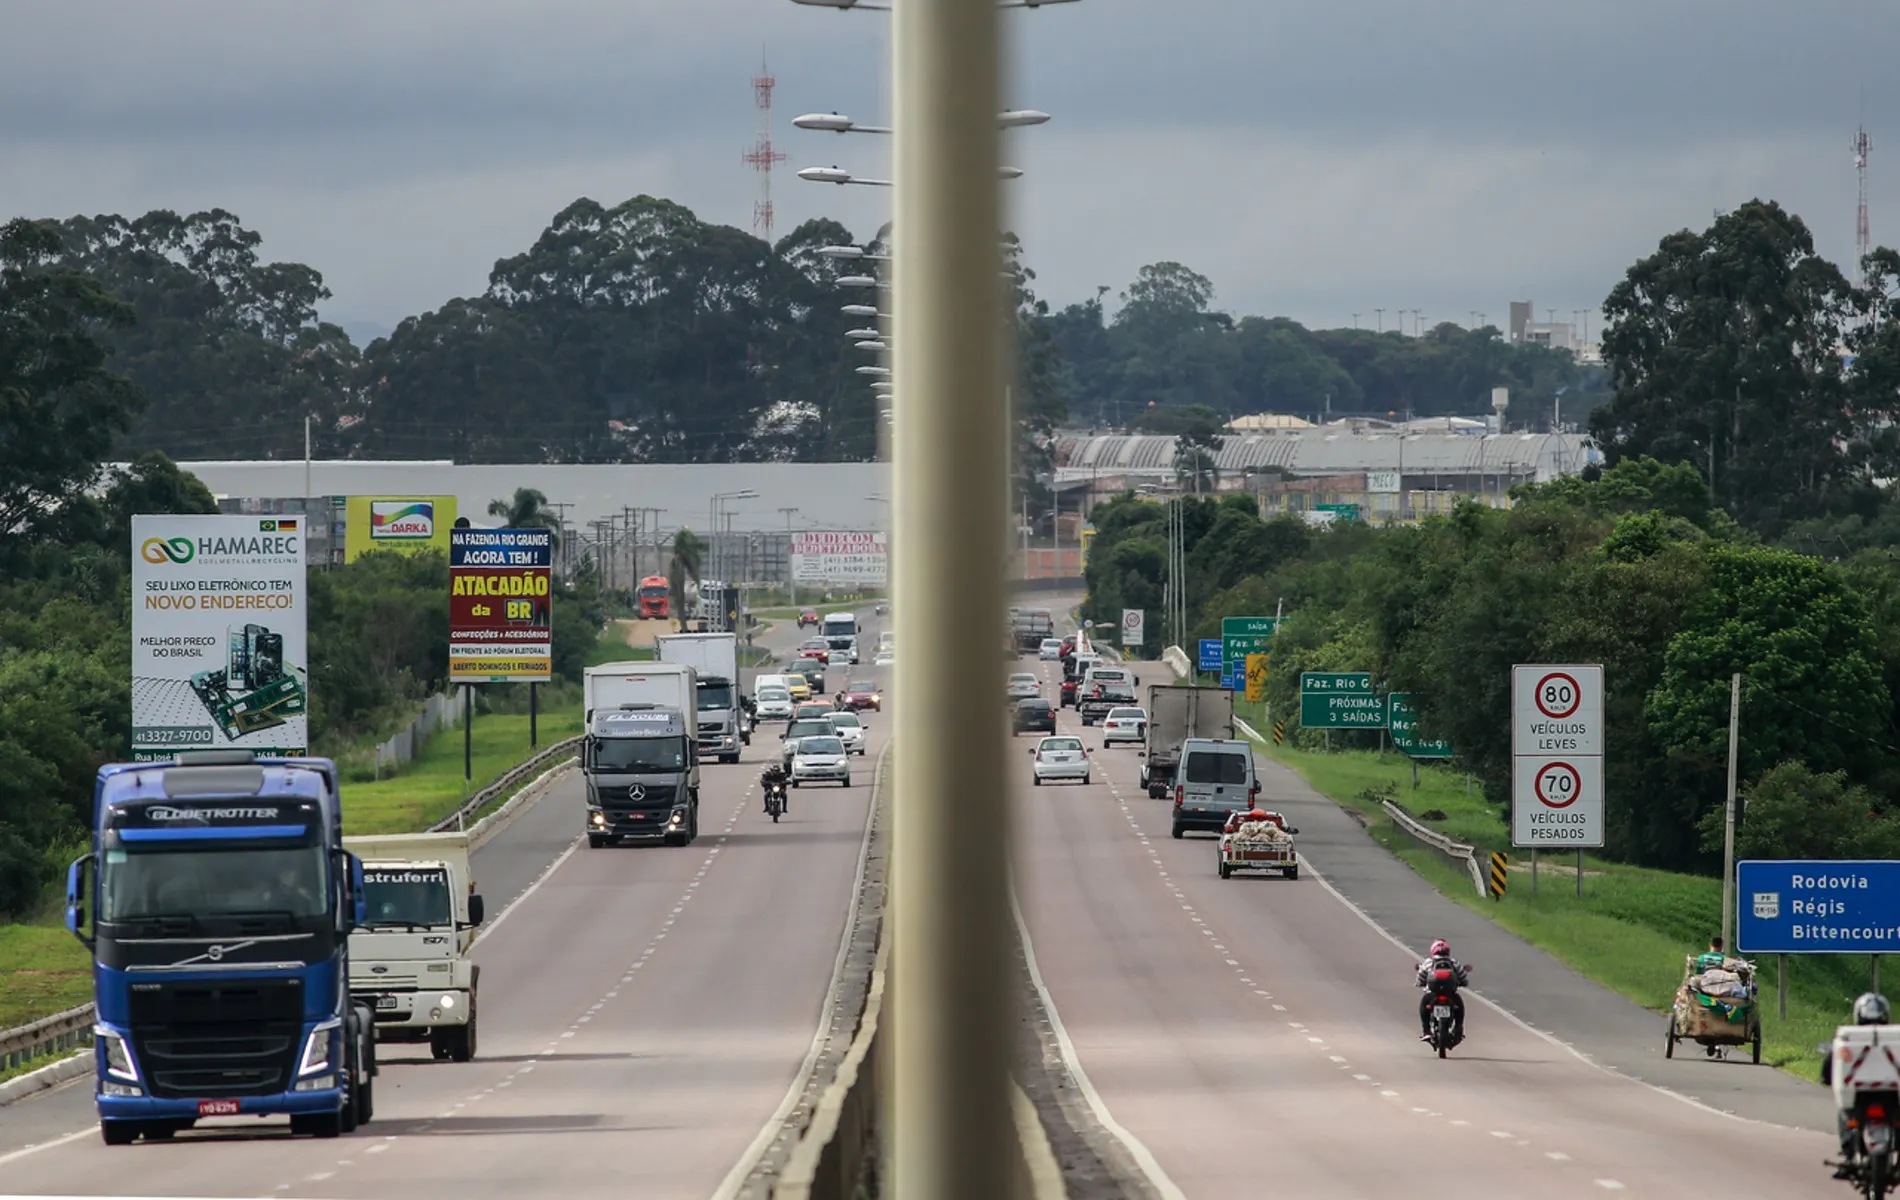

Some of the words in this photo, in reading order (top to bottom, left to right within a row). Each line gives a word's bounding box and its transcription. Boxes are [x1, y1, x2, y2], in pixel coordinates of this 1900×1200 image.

[391, 523, 428, 533] DARKA
[198, 537, 298, 555] HAMAREC
[452, 533, 464, 545] NA
[465, 533, 500, 546] FAZENDA
[501, 534, 515, 546] RIO
[516, 534, 549, 546] GRANDE
[463, 551, 506, 564] AGORA
[508, 551, 532, 564] TEM
[146, 580, 168, 591] SEU
[170, 580, 195, 591] LIXO
[198, 577, 267, 591] ELETRÔNICO
[269, 580, 292, 590] TEM
[452, 571, 549, 596] ATACADÃO
[145, 595, 196, 609] NOVO
[200, 594, 293, 612] ENDEREÇO!
[471, 603, 491, 616] da
[507, 601, 532, 619] BR
[1247, 621, 1268, 630] SAÍDA
[451, 629, 498, 639] CONFECÇÕES
[504, 629, 549, 639] ACESSÓRIOS
[140, 637, 181, 646] MELHOR
[153, 649, 168, 657] DO
[170, 648, 203, 658] BRASIL
[1306, 678, 1331, 688] Faz.
[1335, 678, 1356, 688] Rio
[1545, 686, 1571, 703] 80
[1329, 696, 1382, 708] PRÓXIMAS
[1329, 712, 1337, 722] 3
[1342, 710, 1381, 722] SAÍDAS
[1530, 721, 1586, 734] VEÍCULOS
[1539, 739, 1577, 749] LEVES
[135, 753, 152, 761] Rua
[153, 753, 171, 762] José
[1545, 775, 1571, 792] 70
[152, 807, 279, 820] GLOBETROTTER
[1530, 811, 1586, 823] VEÍCULOS
[1531, 828, 1585, 839] PESADOS
[1792, 874, 1868, 889] Rodovia
[1792, 897, 1845, 917] Régis
